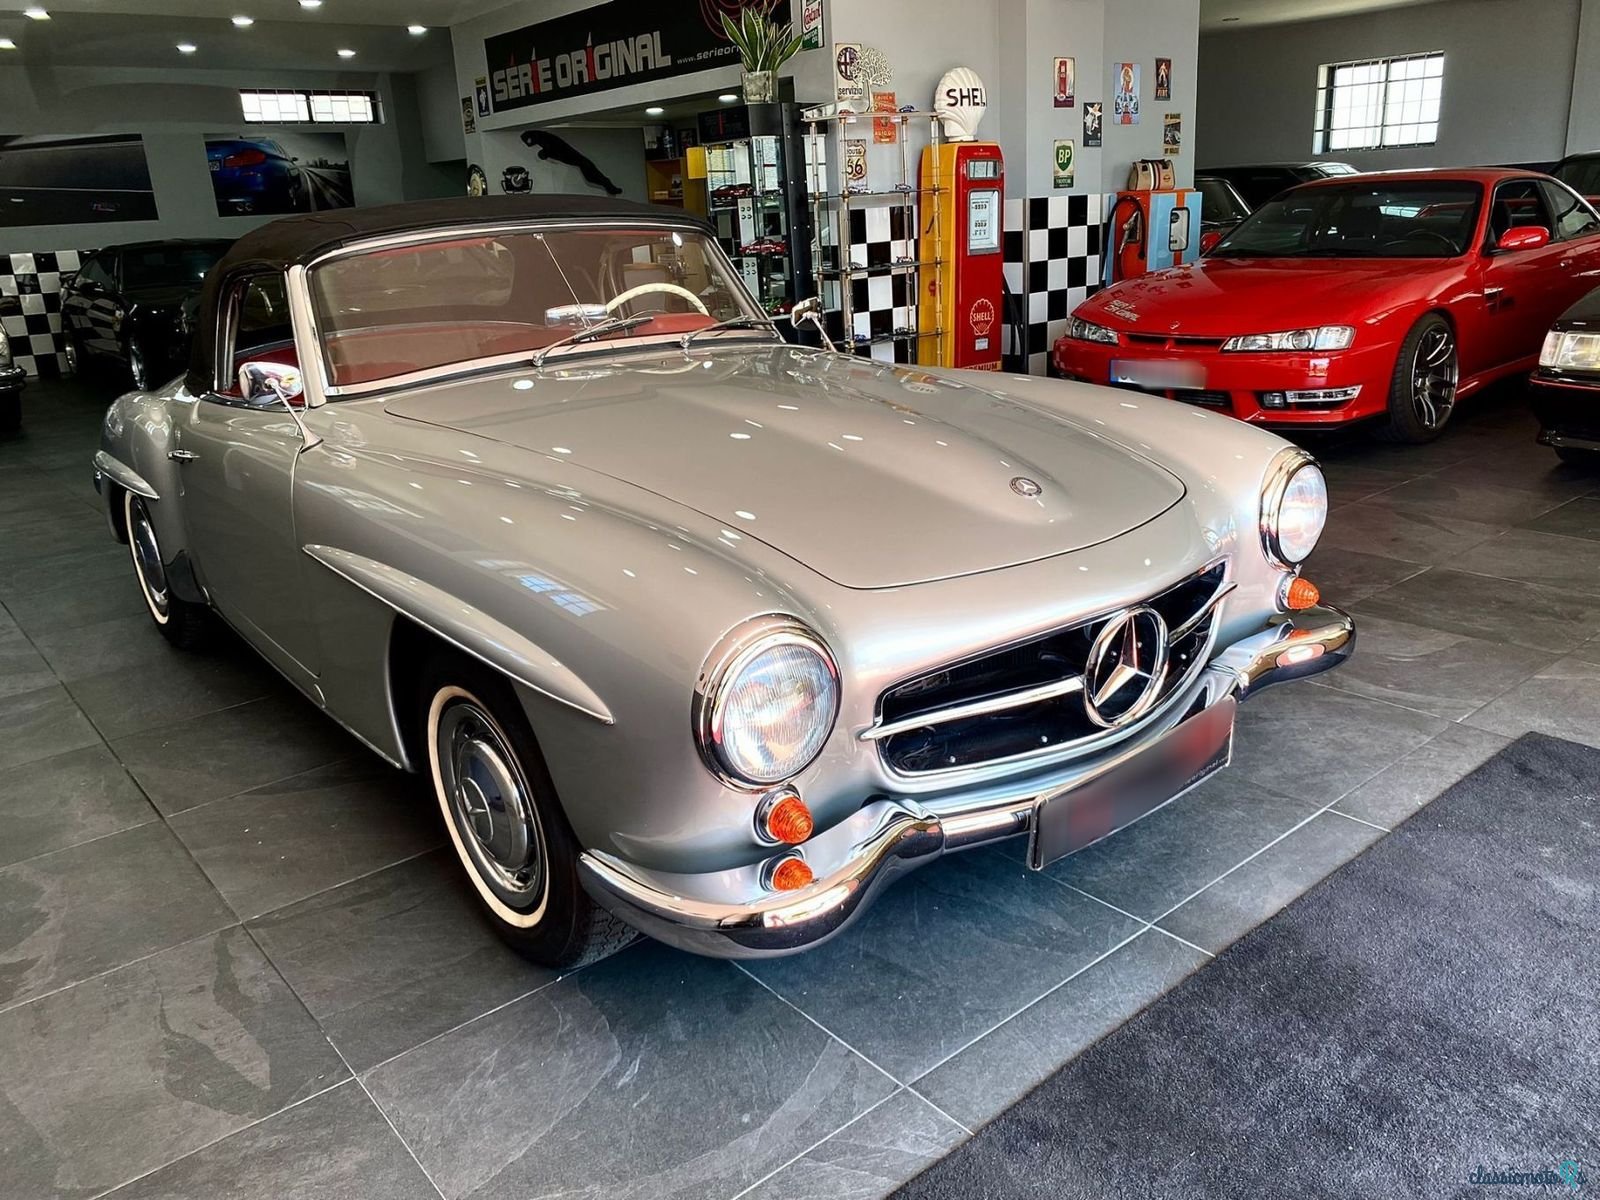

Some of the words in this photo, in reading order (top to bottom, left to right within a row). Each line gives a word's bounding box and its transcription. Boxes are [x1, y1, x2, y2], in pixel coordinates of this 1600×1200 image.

[555, 31, 671, 88] ORIGINAL
[838, 86, 863, 96] servizio
[1058, 149, 1071, 163] BP
[973, 312, 991, 322] SHELL
